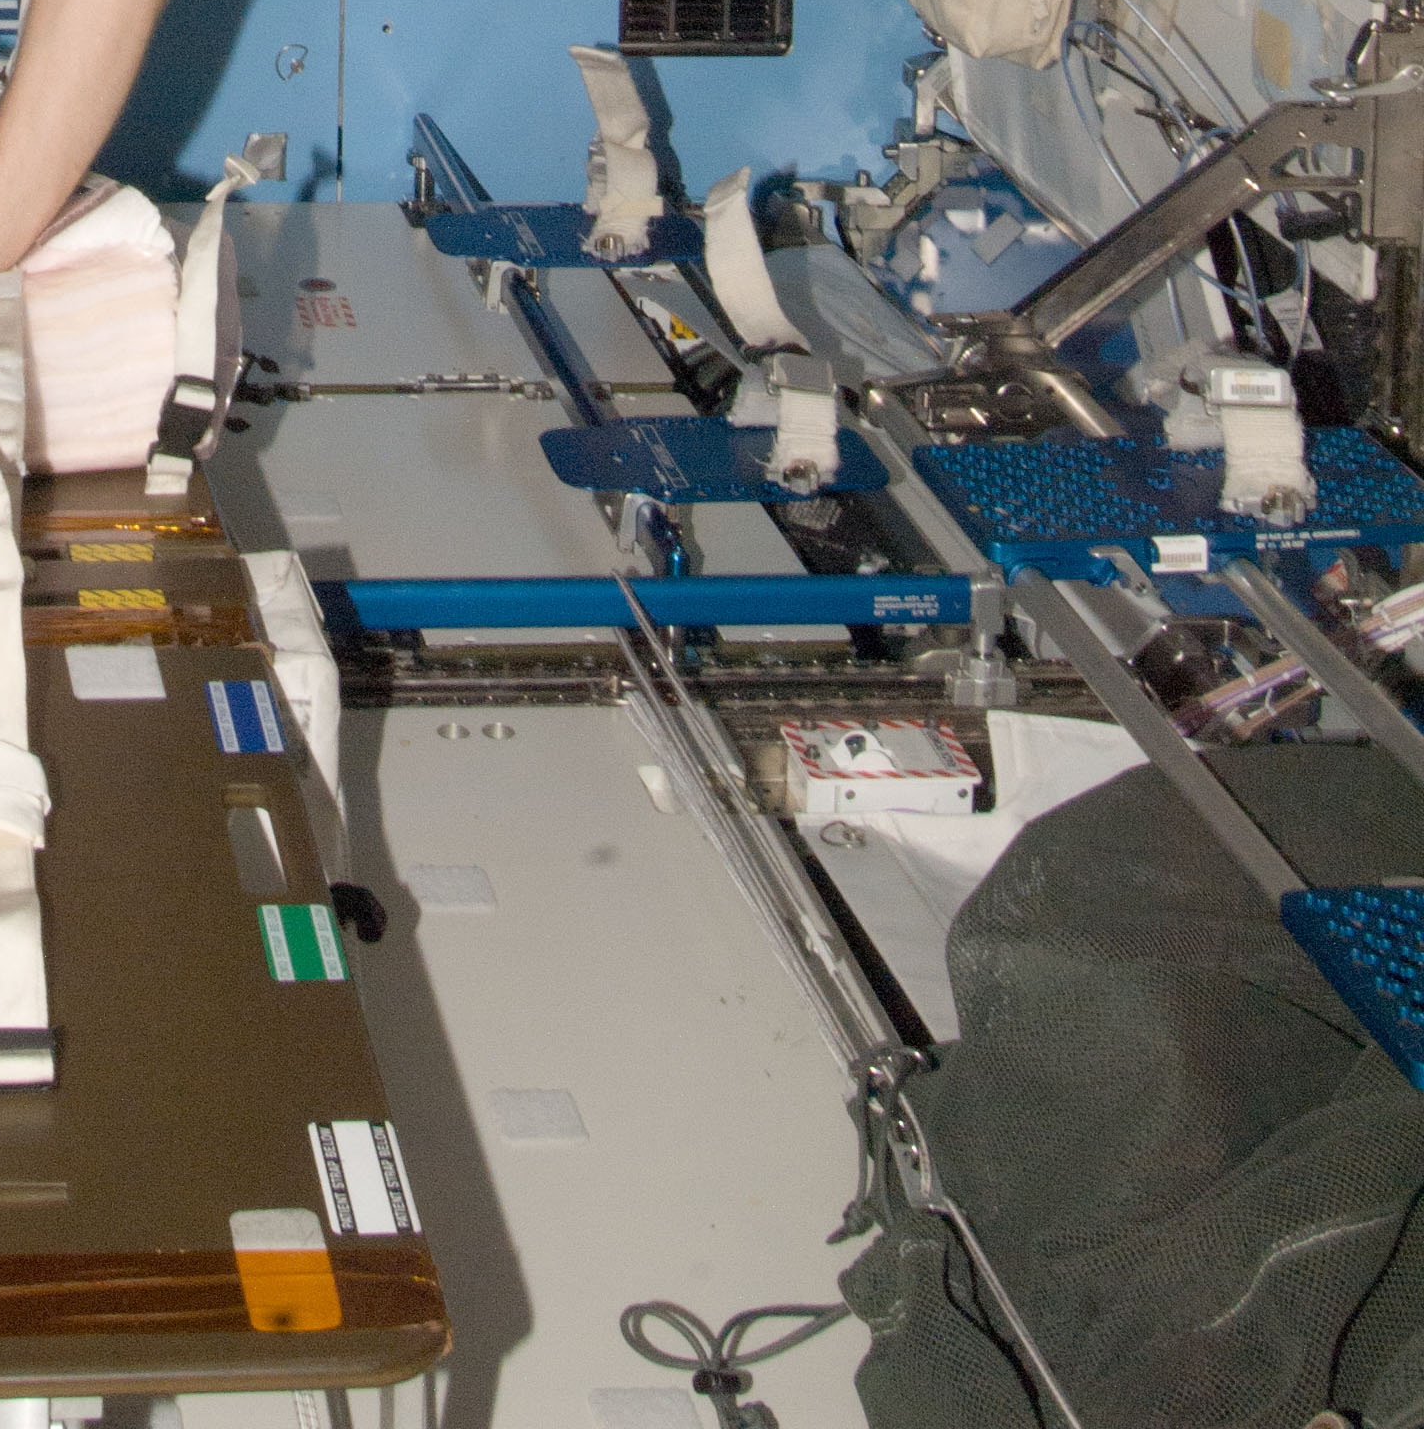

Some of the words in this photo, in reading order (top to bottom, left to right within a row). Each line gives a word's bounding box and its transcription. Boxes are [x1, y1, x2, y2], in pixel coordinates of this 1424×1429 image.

[320, 1127, 337, 1158] BELOW
[374, 1127, 390, 1157] BELOW
[328, 1161, 345, 1190] STRAP
[381, 1160, 400, 1189] STRAP
[335, 1192, 353, 1230] PATIENT
[391, 1191, 409, 1227] PATIENT
